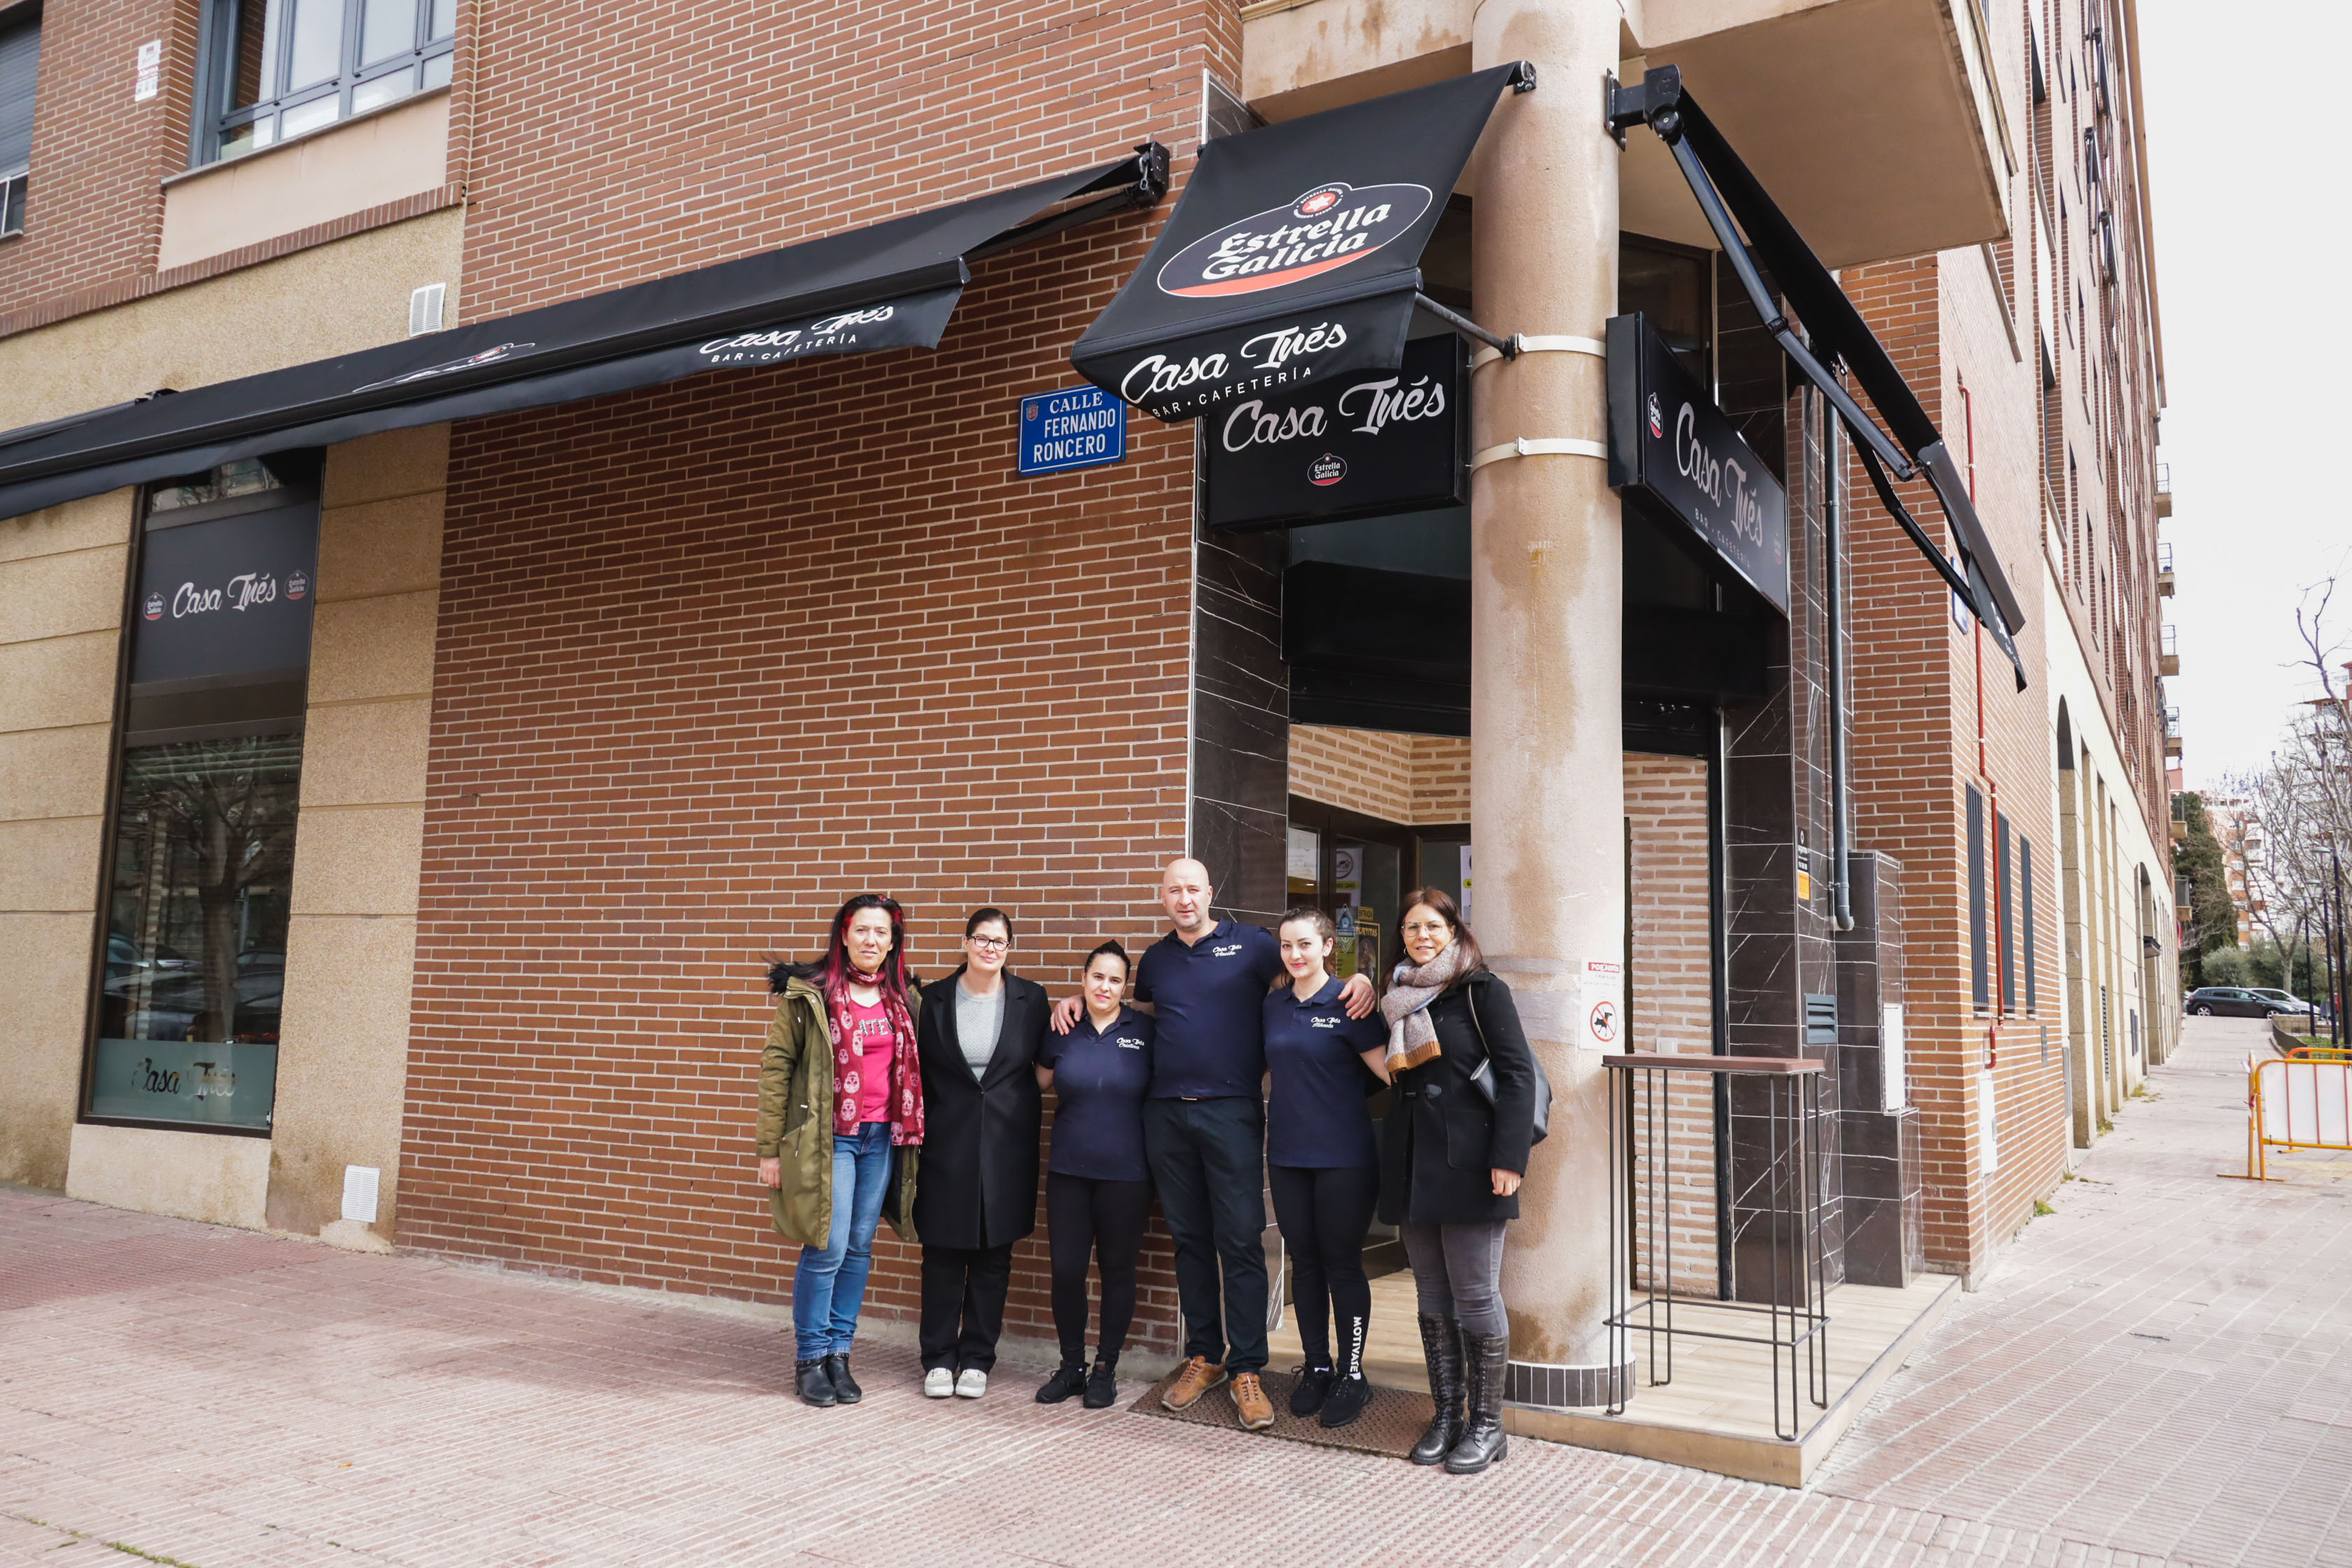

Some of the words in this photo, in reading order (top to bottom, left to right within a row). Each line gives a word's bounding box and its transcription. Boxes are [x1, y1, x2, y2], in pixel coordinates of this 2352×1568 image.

[1208, 204, 1392, 260] Estrella
[1202, 232, 1368, 280] Galicia
[699, 330, 802, 354] Casa
[811, 306, 894, 335] Inés
[711, 353, 743, 363] BAR
[1121, 353, 1229, 404] Casa
[1240, 322, 1347, 369] Inés
[1049, 392, 1103, 414] CALLE
[1153, 401, 1180, 418] BAR
[1199, 367, 1311, 405] CAFETERÍA
[1223, 399, 1327, 452] Casa
[1338, 375, 1446, 436] Inés
[1044, 408, 1116, 438] FERNANDO
[1034, 433, 1106, 463] RONCERO
[1314, 462, 1340, 472] Estrella
[1315, 470, 1339, 479] Galicia
[1676, 402, 1721, 507] Casa
[1725, 458, 1763, 547] Inés
[1695, 507, 1708, 529] BAR
[173, 582, 222, 618] Casa
[227, 572, 276, 612] Inés
[1350, 1316, 1362, 1373] MOTIVATE
